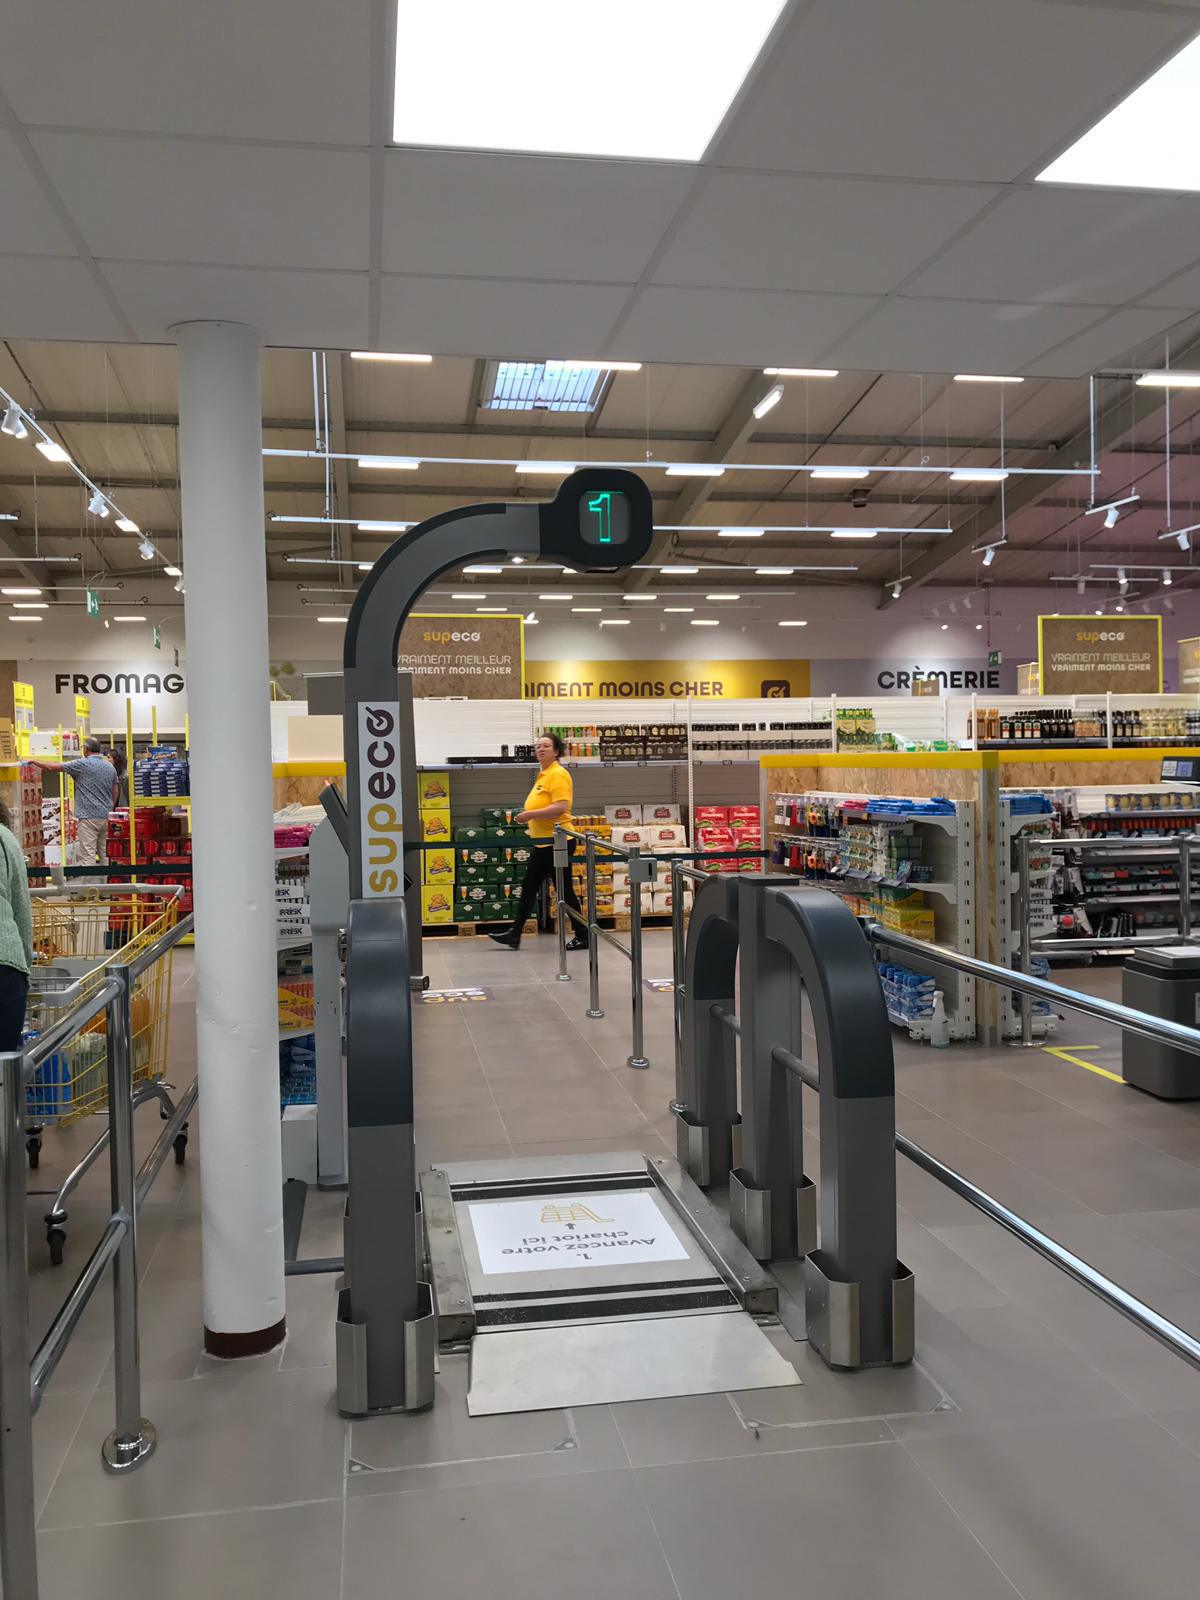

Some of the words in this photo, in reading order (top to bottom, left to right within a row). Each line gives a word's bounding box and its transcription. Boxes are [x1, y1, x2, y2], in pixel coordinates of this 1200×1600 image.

[588, 493, 611, 543] 1
[423, 631, 481, 645] supeco
[455, 654, 512, 665] MEILLEUR
[1051, 653, 1100, 662] VRAIMENT
[1103, 653, 1151, 662] MEILLEUR
[449, 666, 482, 674] MOINS
[484, 666, 512, 674] CHER
[1051, 663, 1095, 672] VRAIMENT
[1098, 663, 1126, 671] MOINS
[1128, 663, 1151, 671] CHER
[877, 665, 1000, 689] CRÈMERIE
[599, 681, 665, 697] MOINS
[669, 681, 724, 696] CHER
[365, 706, 403, 893] supeco
[522, 1235, 547, 1247] ici
[553, 1230, 629, 1243] chariot
[501, 1245, 561, 1256] votre
[565, 1237, 656, 1251] Avancez
